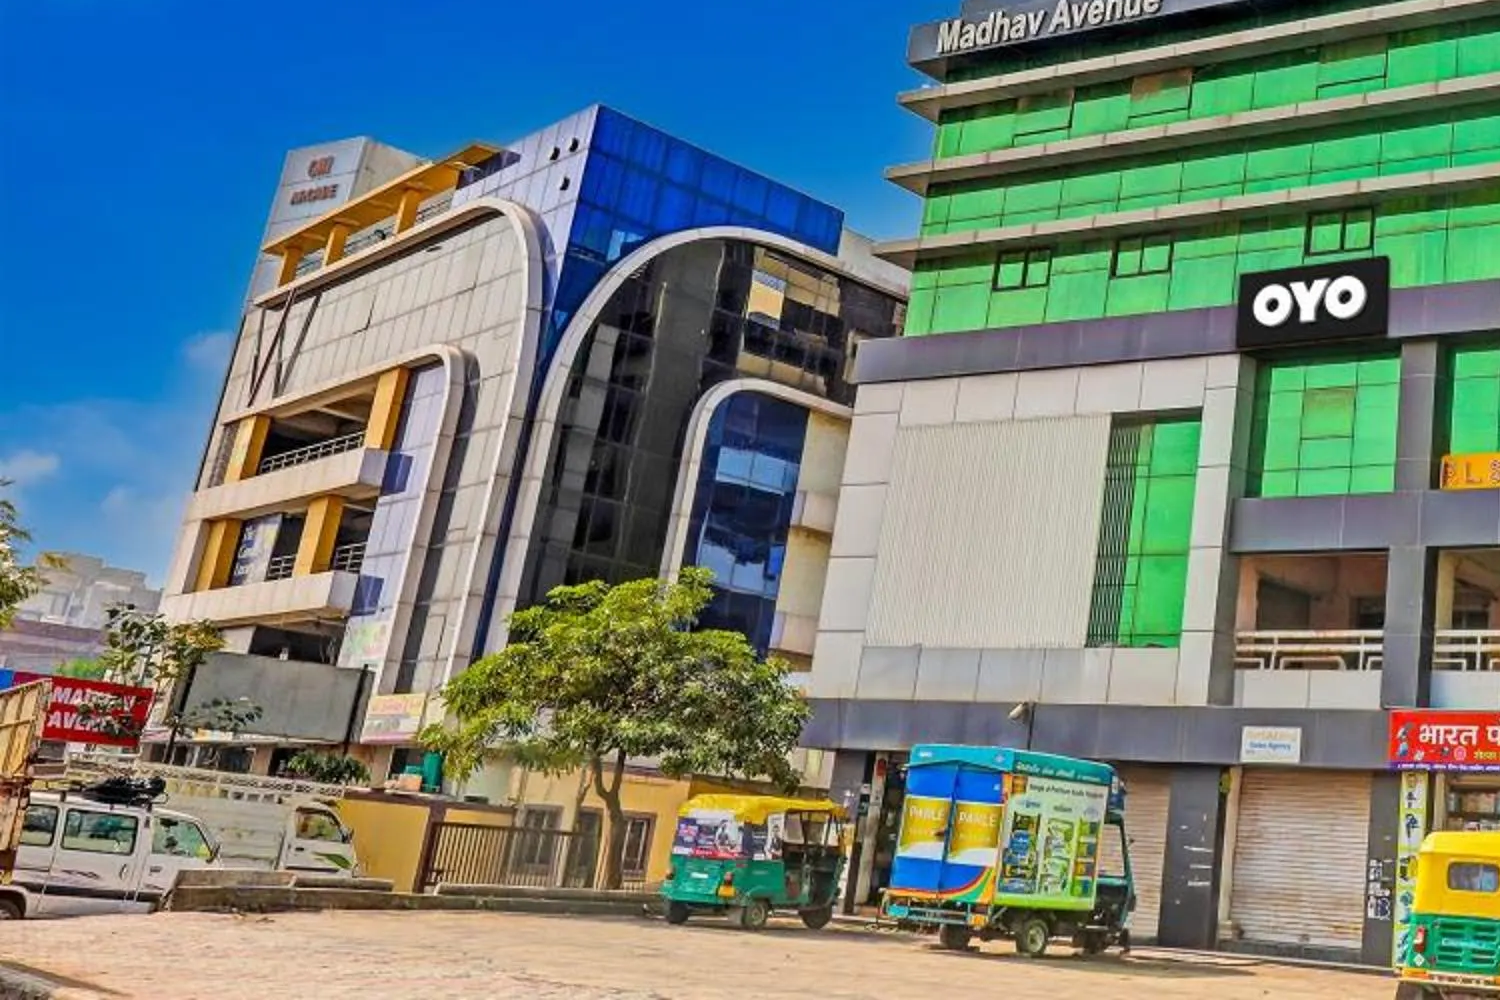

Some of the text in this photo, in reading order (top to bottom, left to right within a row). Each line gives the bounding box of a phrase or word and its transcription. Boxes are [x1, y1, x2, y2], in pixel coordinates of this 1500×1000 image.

[936, 8, 1046, 54] Madhav
[1252, 275, 1368, 328] OYO
[1419, 724, 1479, 746] भारत
